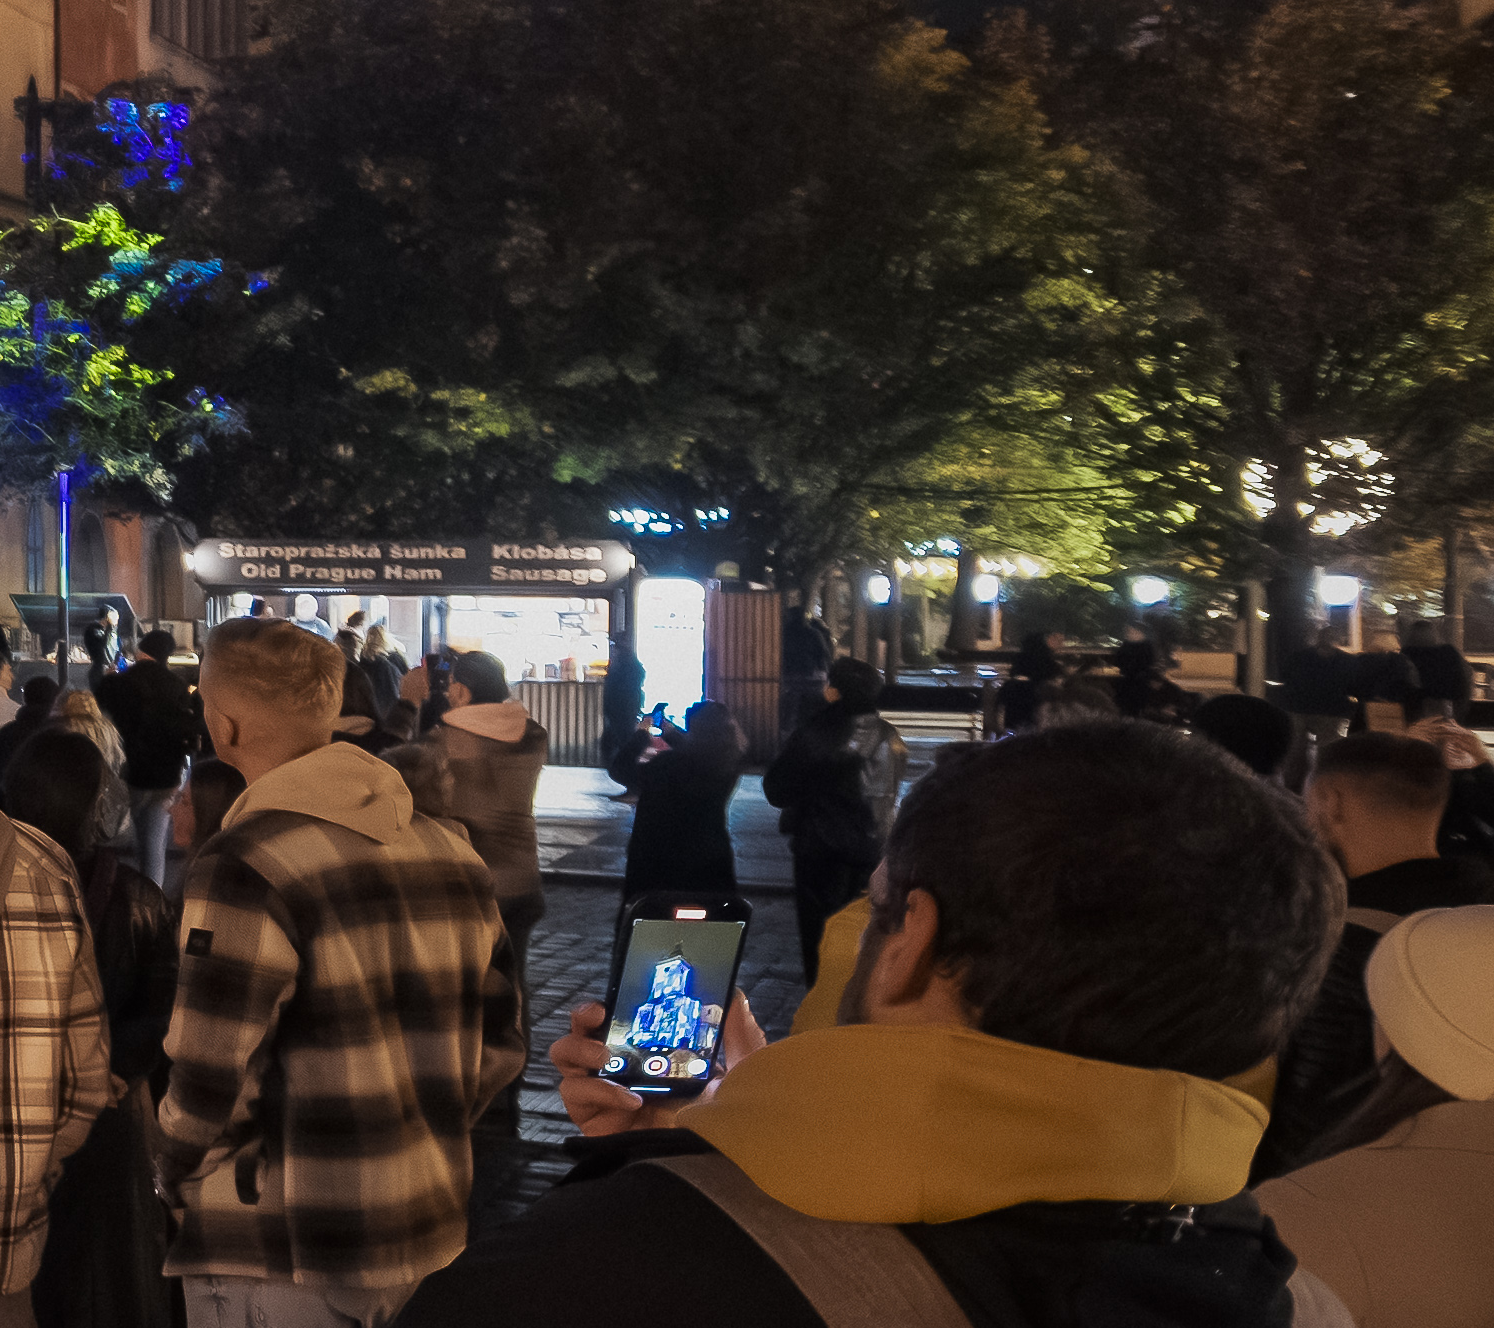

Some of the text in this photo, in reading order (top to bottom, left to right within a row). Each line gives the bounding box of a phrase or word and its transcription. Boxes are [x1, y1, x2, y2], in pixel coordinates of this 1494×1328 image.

[218, 542, 603, 562] Staropražská šunka Klobása
[240, 562, 608, 586] Old Prague Ham Sausage
